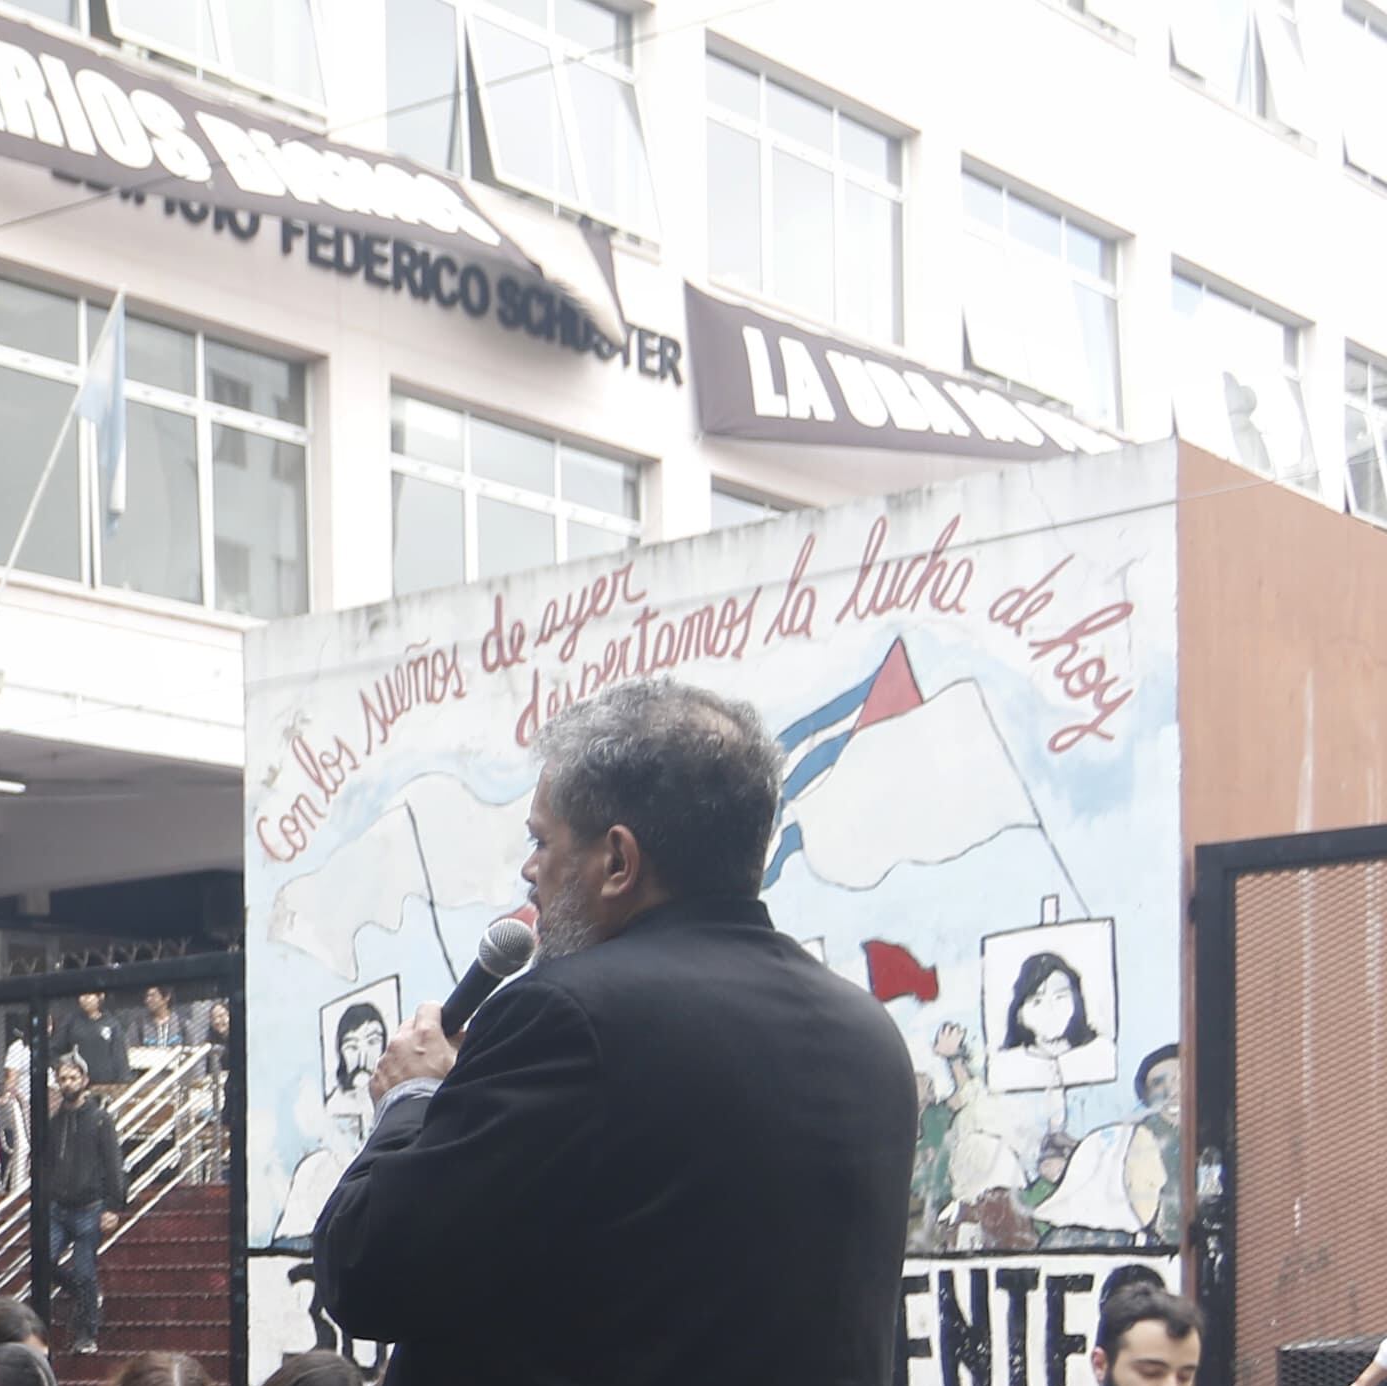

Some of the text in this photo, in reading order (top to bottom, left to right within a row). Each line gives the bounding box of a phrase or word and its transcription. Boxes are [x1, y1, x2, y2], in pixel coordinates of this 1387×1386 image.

[280, 214, 490, 317] FEDERICO
[742, 325, 836, 422] LA
[763, 531, 817, 645] la
[835, 513, 975, 624] lucha
[988, 553, 1075, 637] de
[256, 561, 647, 863] Con los sueños de ayer
[1029, 601, 1135, 753] hoy
